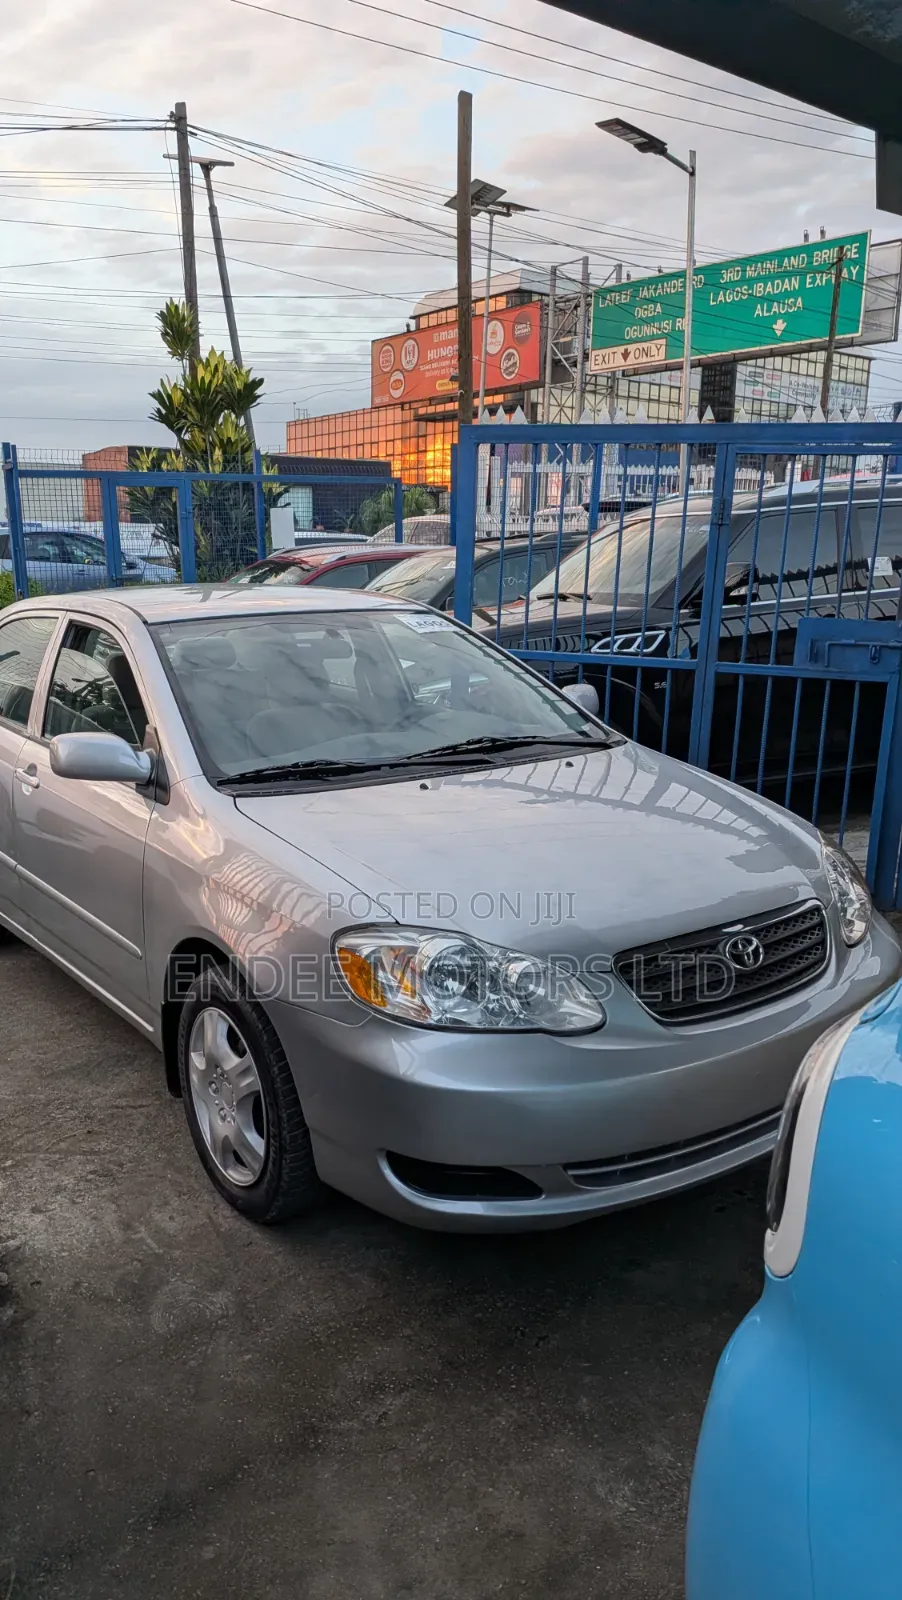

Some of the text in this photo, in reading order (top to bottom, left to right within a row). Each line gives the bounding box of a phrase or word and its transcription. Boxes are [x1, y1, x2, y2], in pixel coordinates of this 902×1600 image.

[720, 265, 742, 285] 3RD
[745, 253, 808, 279] MAINLAND
[599, 288, 634, 308] LATEEF
[635, 278, 685, 301] JAKANDE
[709, 276, 800, 306] LAGOS-IBADAN
[634, 302, 663, 319] OGBA
[753, 296, 804, 318] ALAUSA
[624, 319, 672, 340] OGUNNUSI
[593, 343, 664, 367] EXIT ONLY
